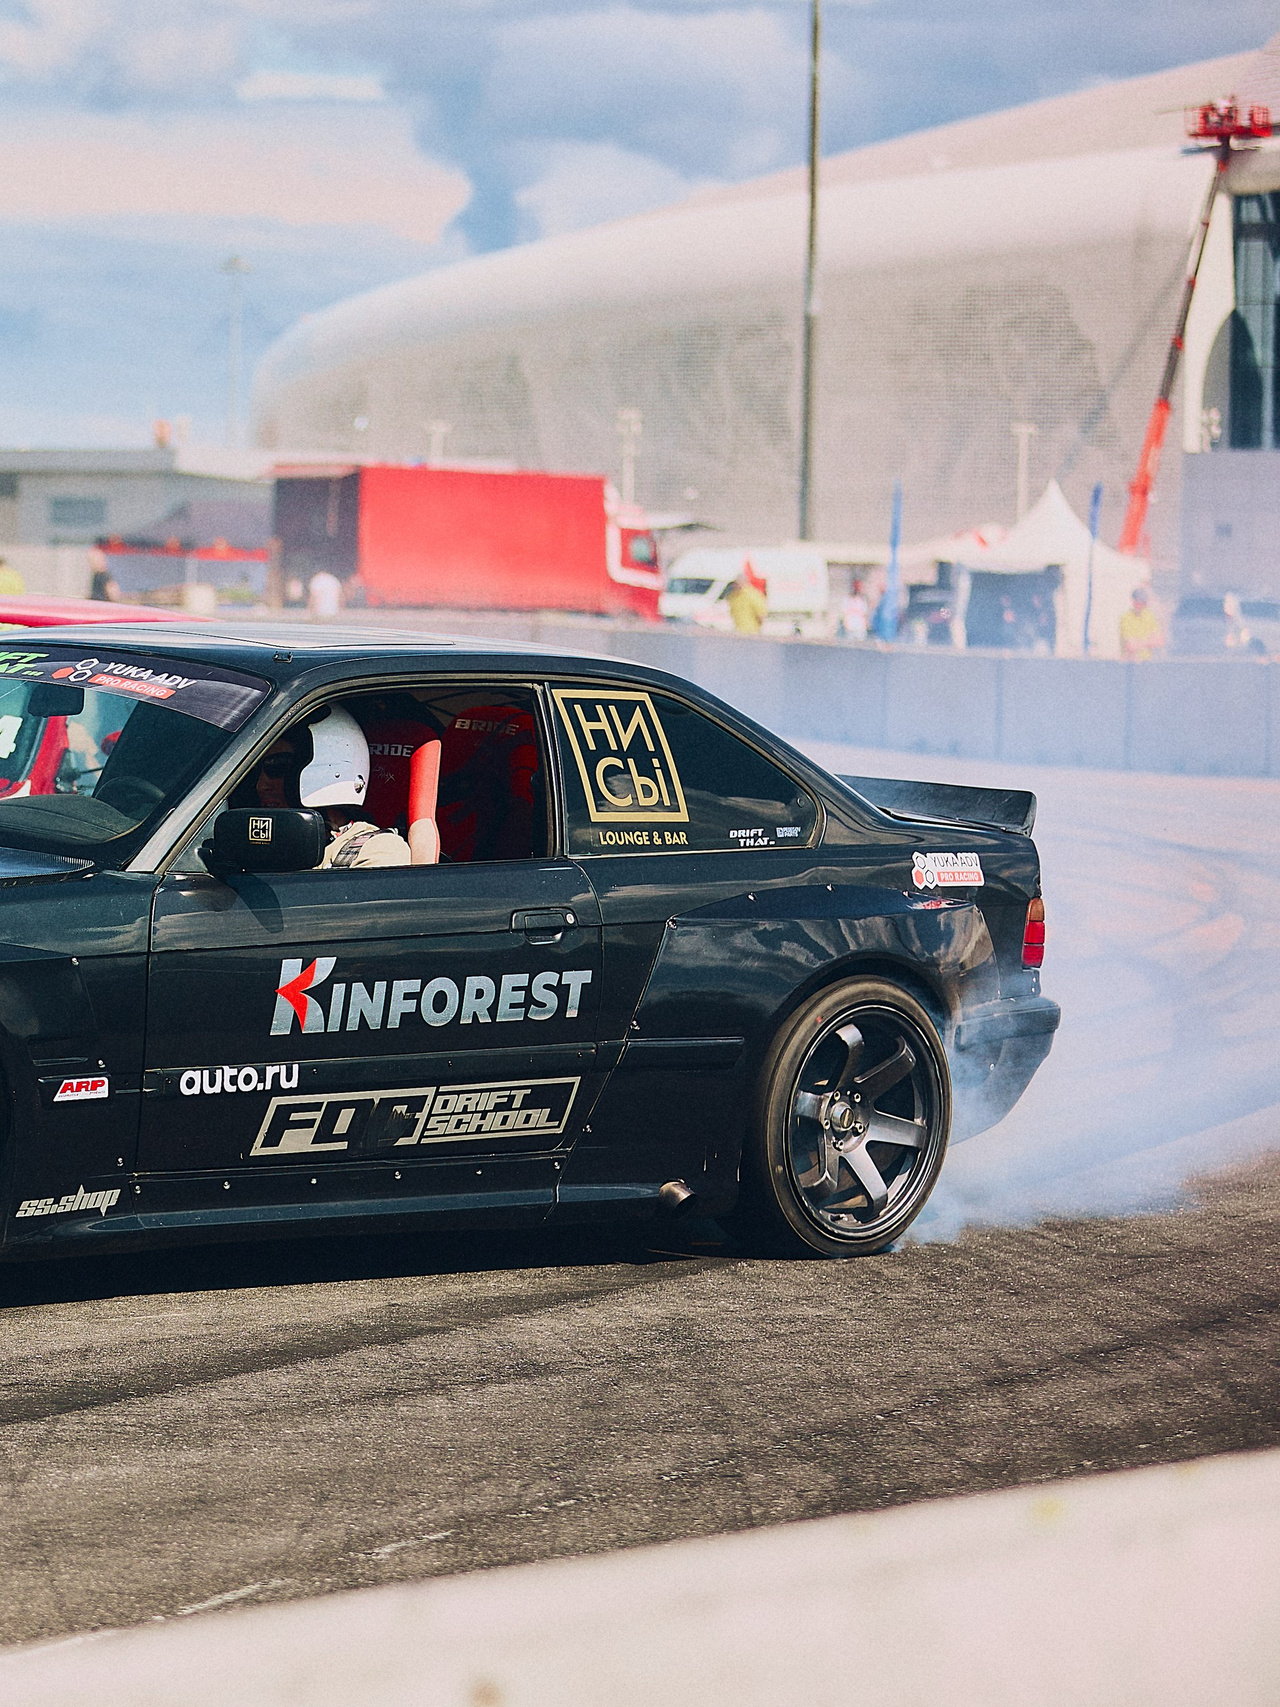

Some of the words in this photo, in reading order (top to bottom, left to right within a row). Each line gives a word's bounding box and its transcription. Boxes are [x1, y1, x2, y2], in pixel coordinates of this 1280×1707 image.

[95, 675, 120, 686] PRO
[121, 680, 168, 697] RACING
[573, 704, 656, 752] НИ
[368, 743, 415, 758] RIDE
[252, 819, 269, 830] НИ
[729, 828, 764, 839] DRIFT
[599, 831, 651, 845] LOUNGE
[652, 831, 663, 845] &
[665, 831, 689, 845] BAR
[939, 872, 955, 882] PRO
[954, 872, 980, 881] RACING
[270, 956, 593, 1036] KINFOREST
[59, 1079, 106, 1094] ARP
[179, 1063, 300, 1096] auto.ru
[431, 1088, 532, 1115] DRIFT
[423, 1107, 564, 1137] SCHOOL
[15, 1183, 122, 1218] ss.shop
